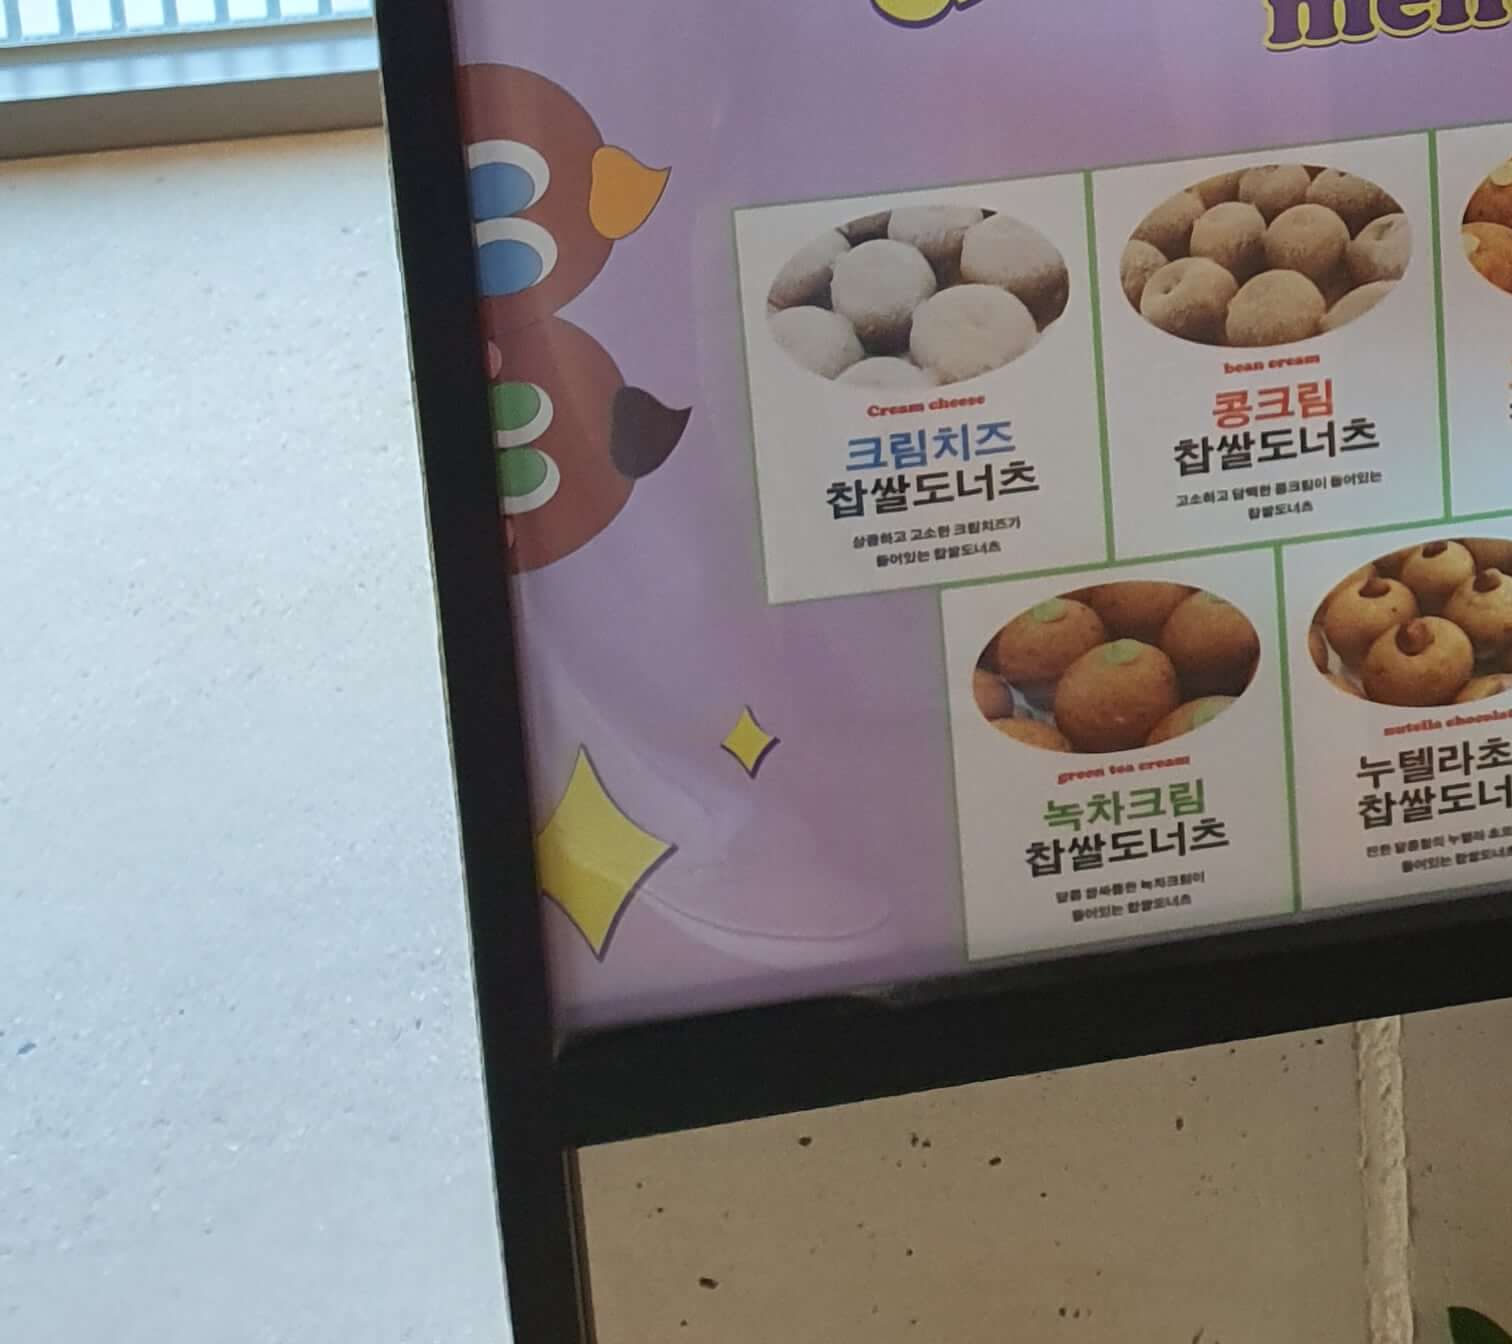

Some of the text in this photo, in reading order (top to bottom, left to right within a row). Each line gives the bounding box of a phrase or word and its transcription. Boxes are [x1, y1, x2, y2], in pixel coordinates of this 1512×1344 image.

[1223, 354, 1321, 375] bean cream
[867, 394, 986, 417] Cream cheese
[1212, 378, 1334, 429] 콩크림
[845, 420, 1017, 472] 크림치즈
[1173, 416, 1380, 477] 찹쌀도너츠
[825, 459, 1041, 519] 찹쌀도너츠
[1057, 768, 1105, 785] green
[1138, 755, 1191, 772] cream
[1043, 778, 1206, 832] 녹차크림
[1024, 817, 1230, 878] 찹쌀도너츠
